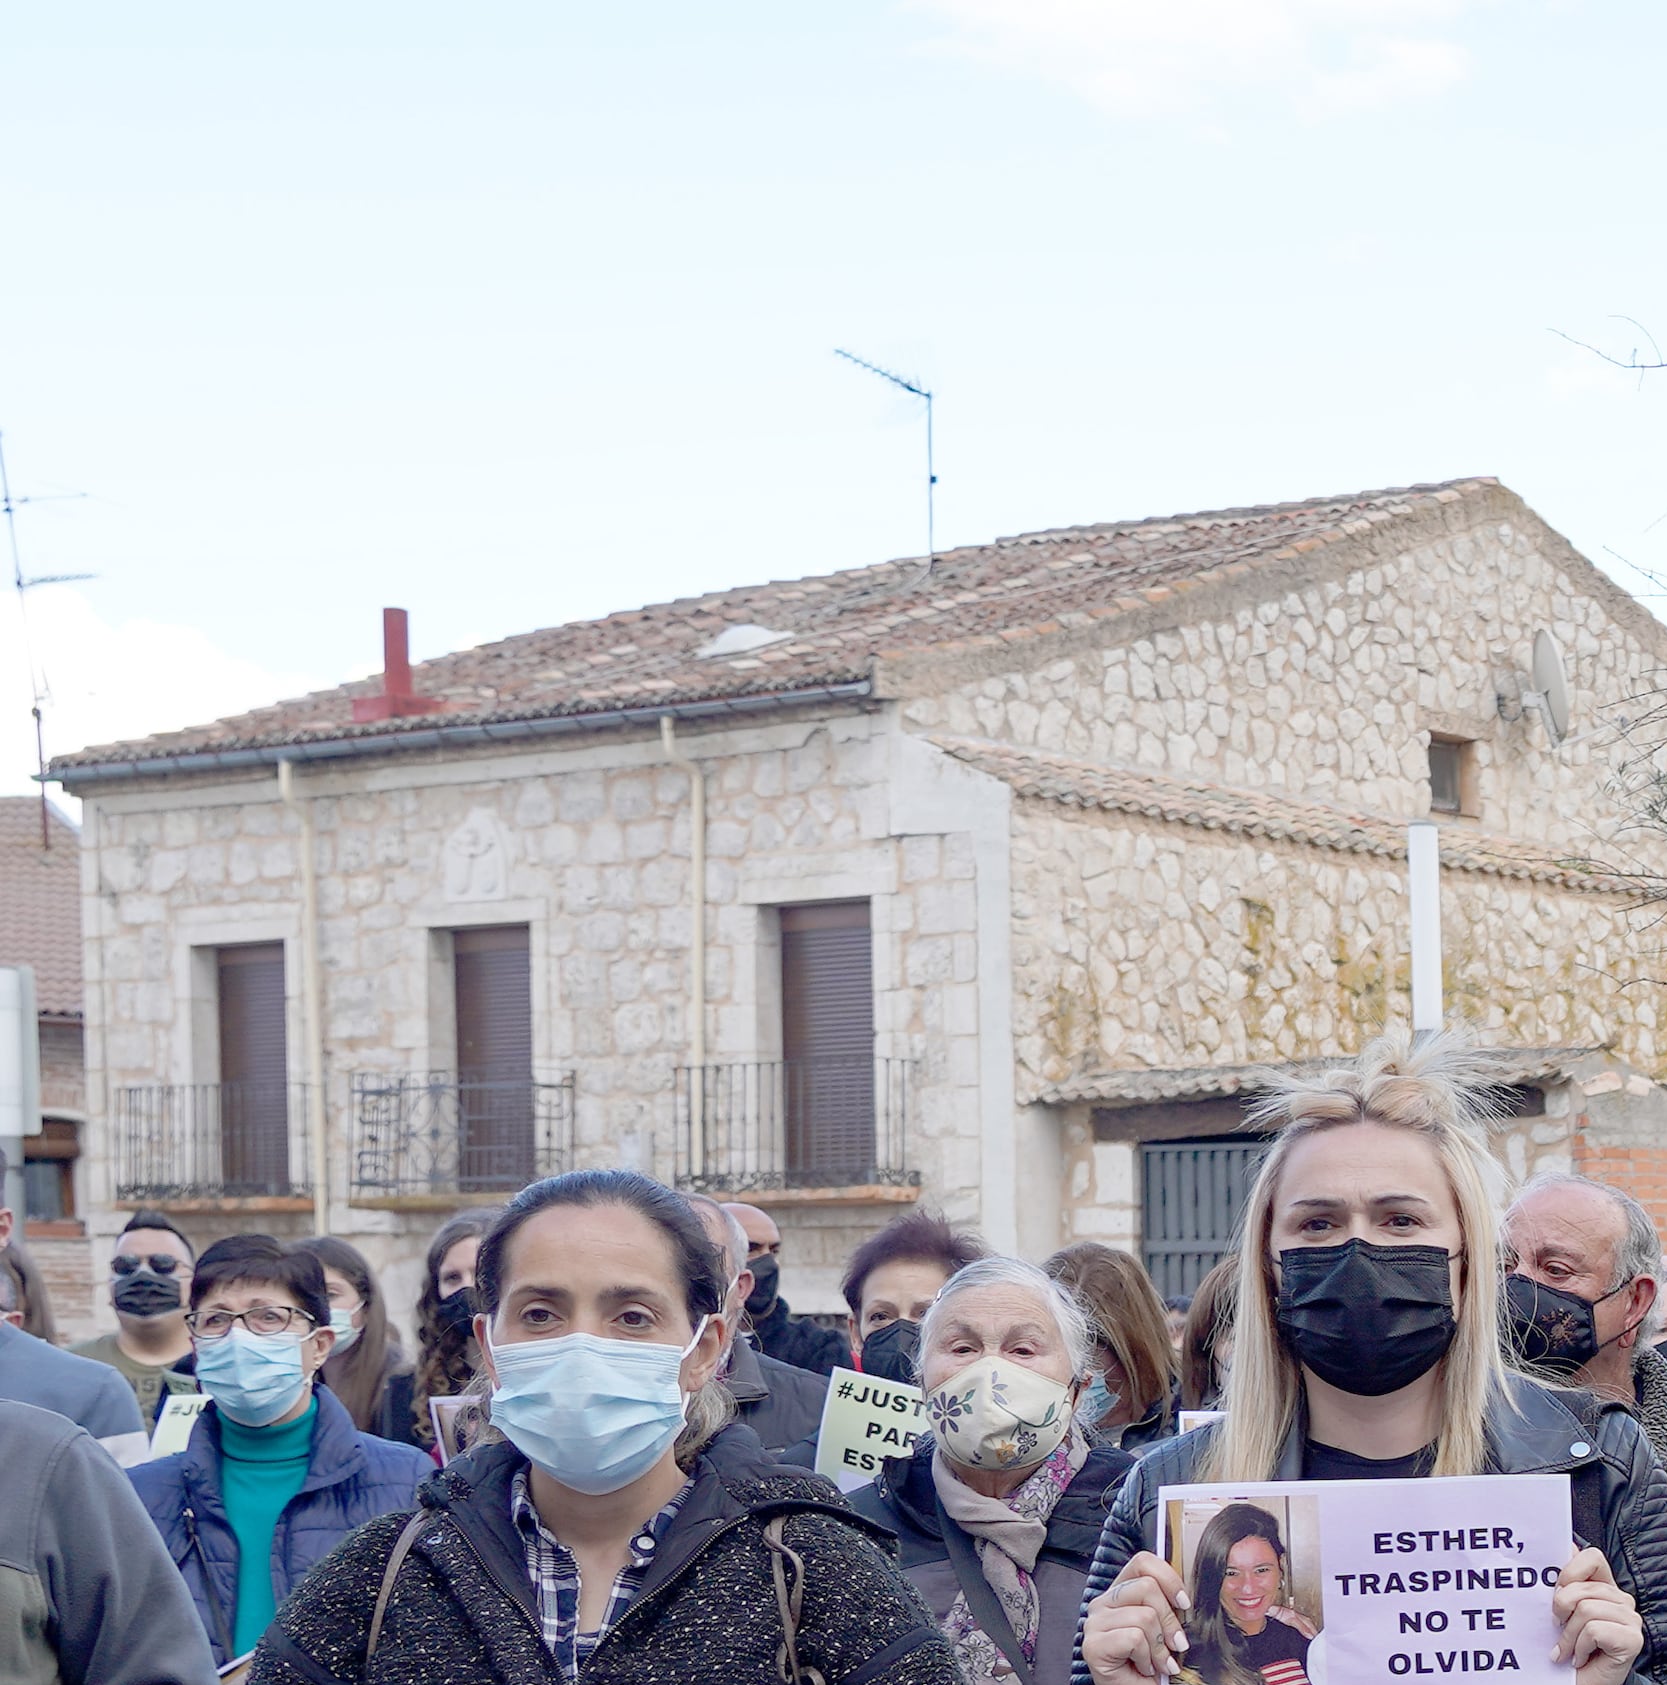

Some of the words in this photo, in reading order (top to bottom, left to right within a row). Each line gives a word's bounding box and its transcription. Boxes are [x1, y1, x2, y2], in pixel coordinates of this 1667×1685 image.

[1374, 1527, 1524, 1553] ESTHER,
[1335, 1566, 1562, 1596] TRASPINEDO
[1399, 1610, 1449, 1633] NO
[1461, 1608, 1505, 1631] TE
[1388, 1649, 1520, 1675] OLVIDA
